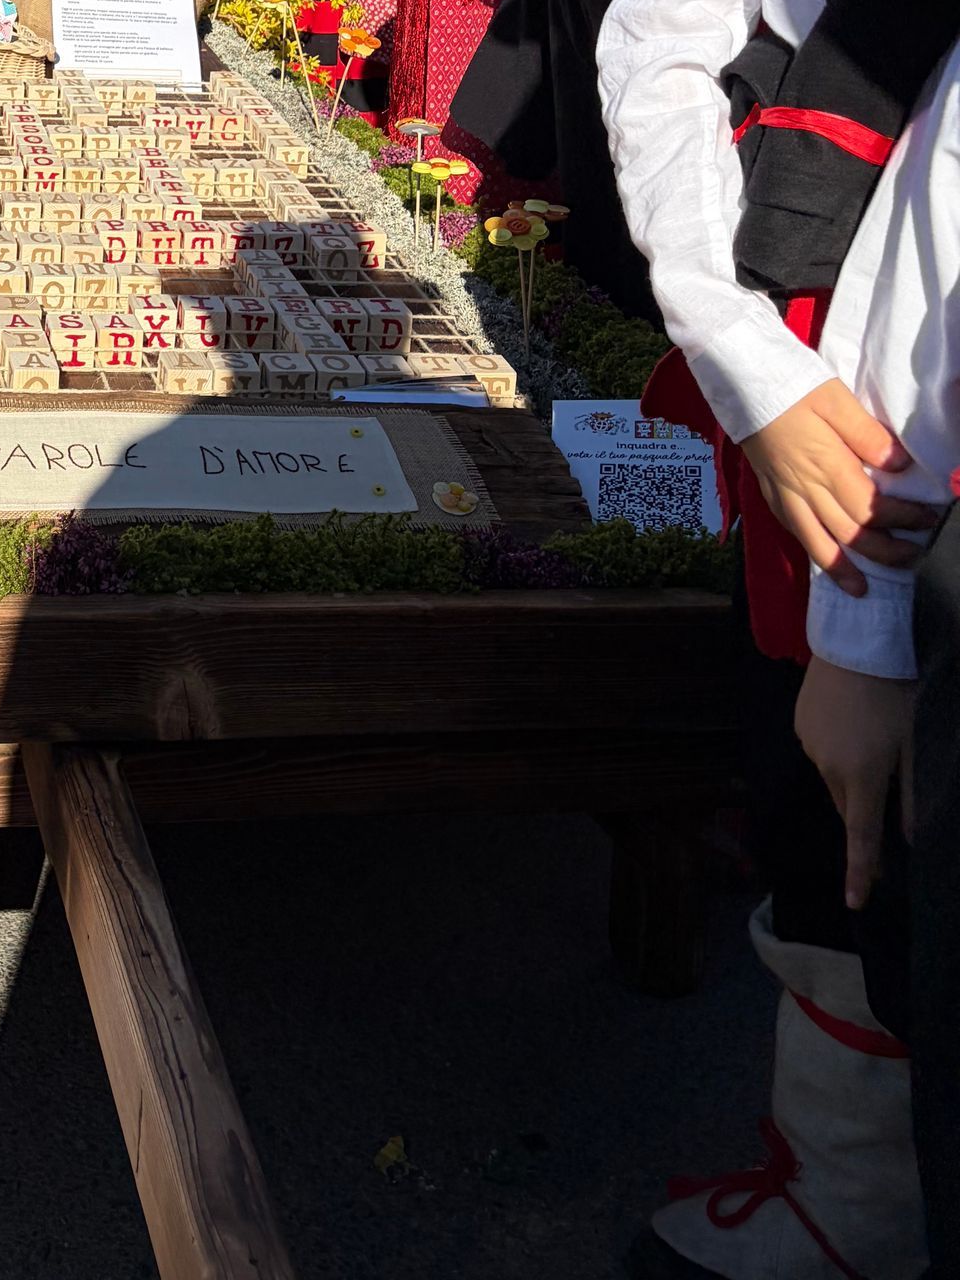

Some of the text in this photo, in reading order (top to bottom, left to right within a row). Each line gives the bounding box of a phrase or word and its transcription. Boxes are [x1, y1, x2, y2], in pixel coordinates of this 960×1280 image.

[616, 441, 667, 451] inquadra
[201, 445, 356, 475] D'AMORE
[595, 450, 607, 459] il
[608, 451, 628, 460] tuo
[628, 450, 682, 463] pasquale
